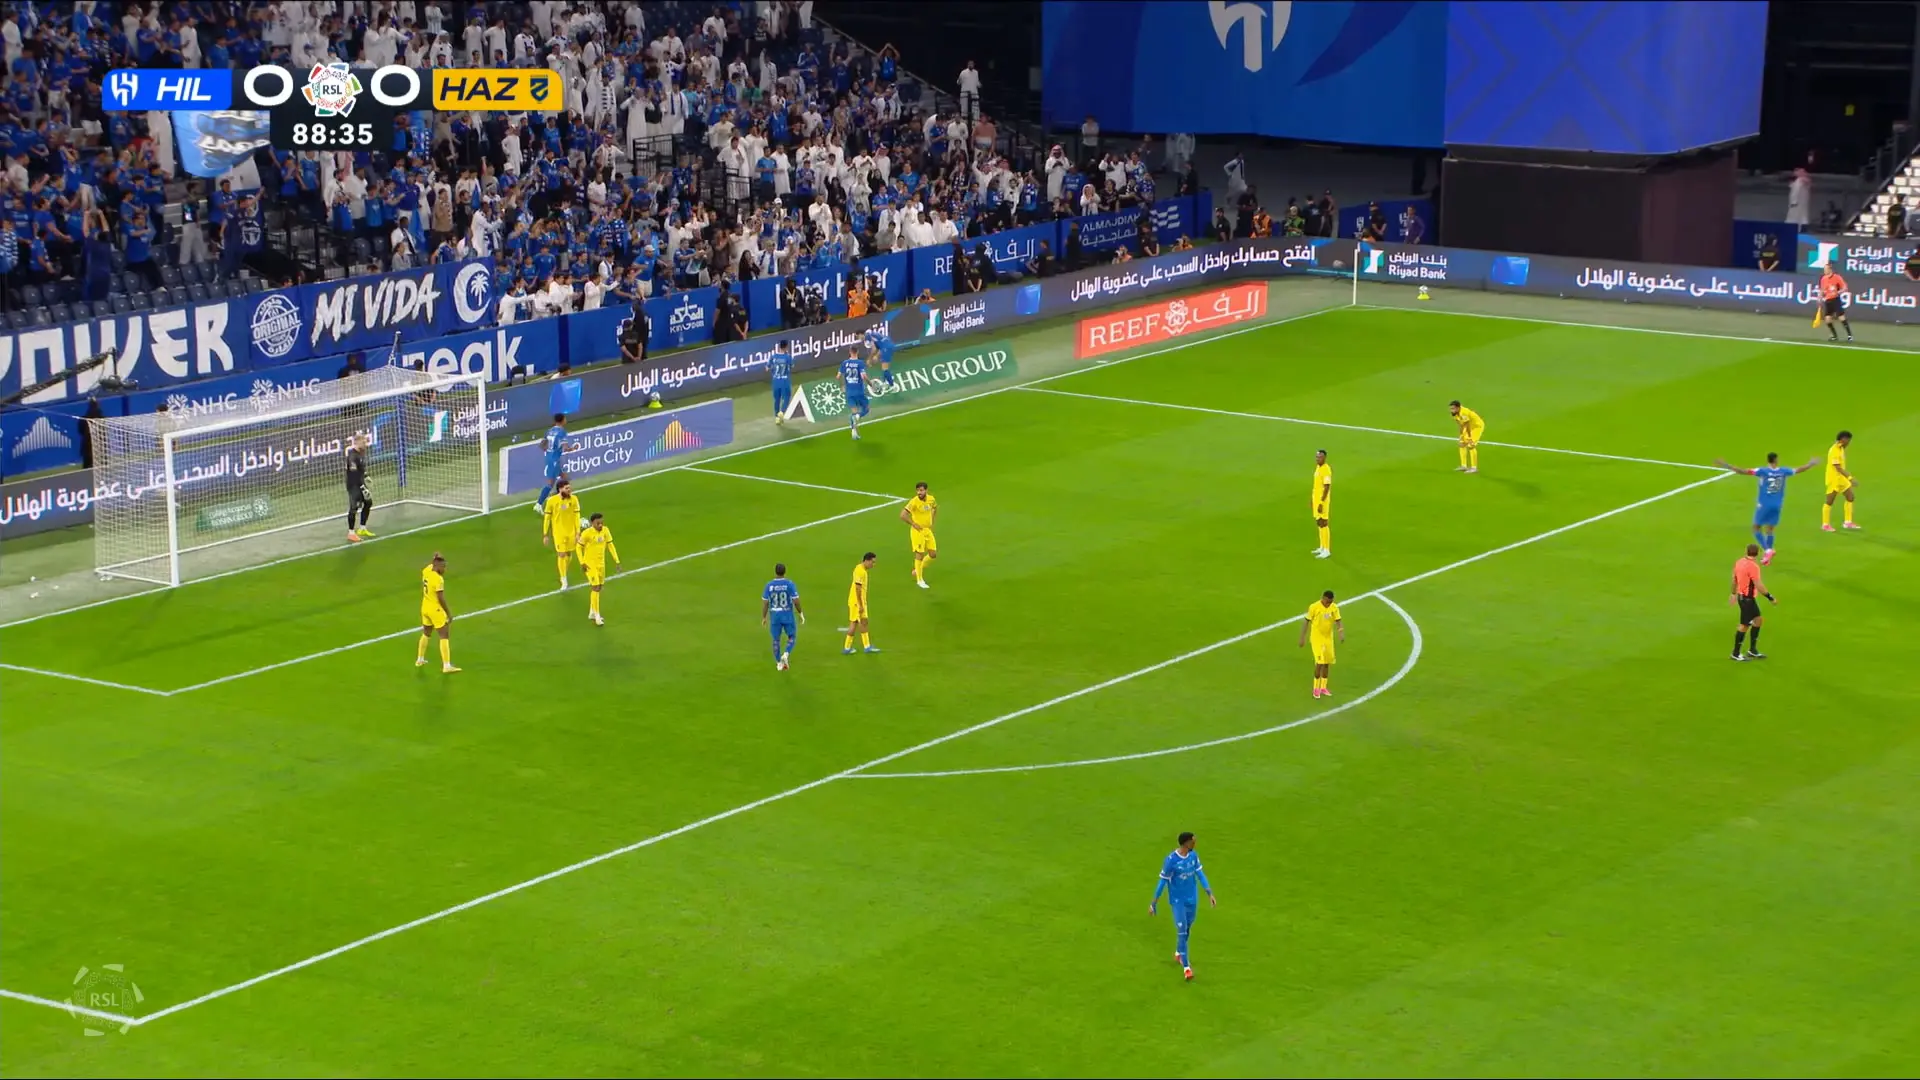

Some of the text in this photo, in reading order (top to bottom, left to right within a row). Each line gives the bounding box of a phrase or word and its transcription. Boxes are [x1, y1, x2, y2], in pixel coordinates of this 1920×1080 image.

[1388, 251, 1448, 267] بنك الرياض
[1846, 245, 1893, 260] الرياض
[1071, 245, 1316, 302] افتح حسابك وادخل السحب على عضوية الهلال
[1388, 264, 1447, 280] Riyad Bank
[1846, 258, 1892, 274] Riyad
[1576, 267, 1624, 290] الهلال
[1627, 271, 1687, 294] عضوية
[1690, 276, 1729, 297] على
[1732, 277, 1794, 300] السحب
[943, 299, 986, 319] بنك الرياض
[1855, 287, 1917, 309] حسابك
[311, 272, 441, 348] MI VIDA
[253, 312, 302, 340] ORIGINAL
[943, 314, 985, 333] Riyad Bank
[1090, 313, 1161, 349] REEF
[0, 302, 235, 405] OWER
[662, 362, 707, 388] عضوية
[709, 353, 738, 378] على
[931, 350, 1007, 383] GROUP
[277, 378, 321, 401] NHC
[621, 367, 659, 397] الهلال
[192, 393, 238, 416] NHC
[484, 415, 508, 431] Bank
[288, 437, 341, 464] حسابك
[593, 429, 634, 450] مدينة
[234, 446, 284, 477] وادخل
[603, 448, 633, 465] City
[57, 480, 122, 511] عضوية
[127, 469, 167, 500] على
[0, 488, 53, 525] الهلال
[771, 591, 789, 608] 38
